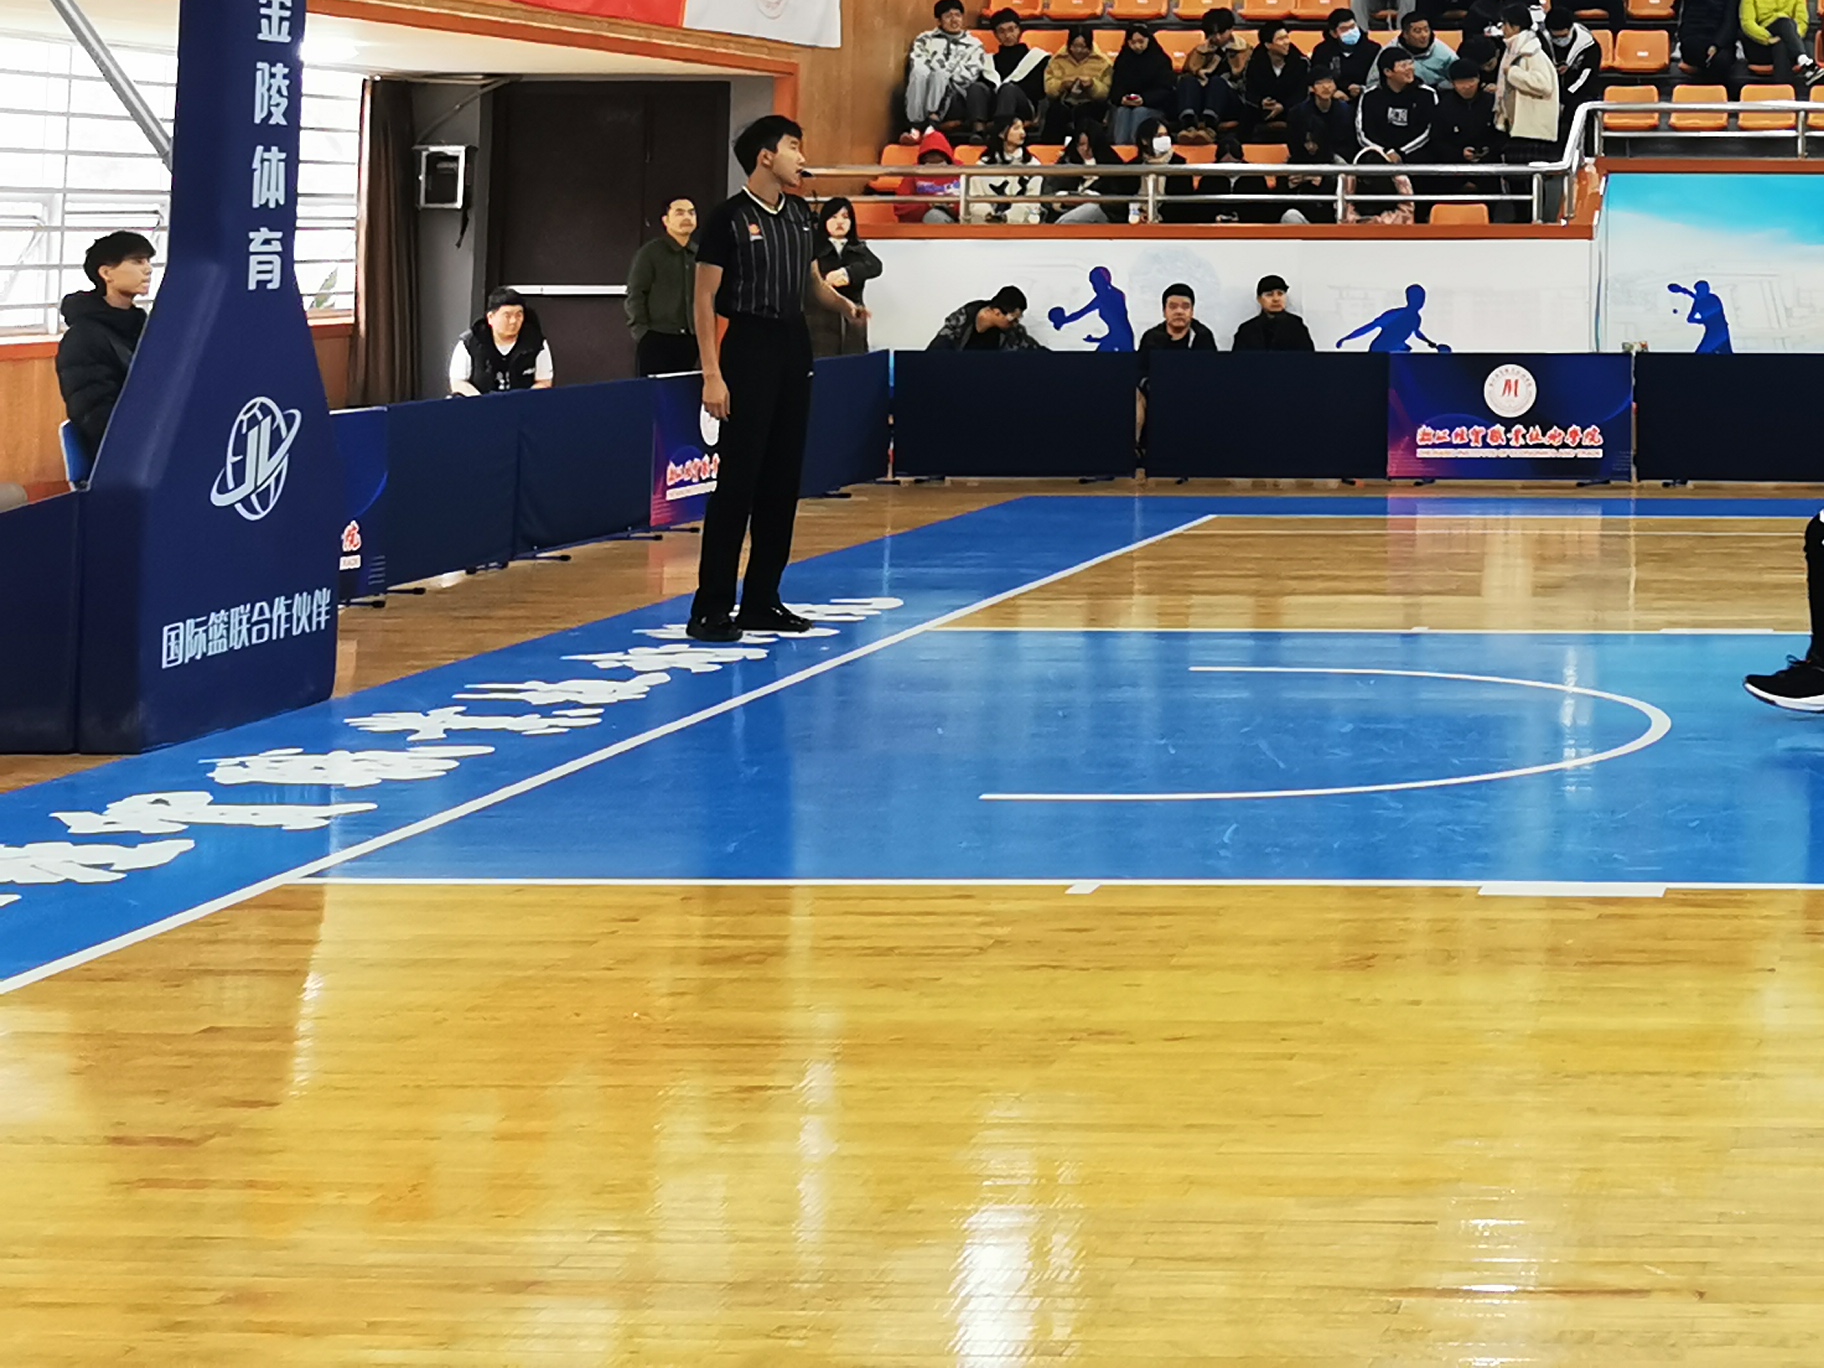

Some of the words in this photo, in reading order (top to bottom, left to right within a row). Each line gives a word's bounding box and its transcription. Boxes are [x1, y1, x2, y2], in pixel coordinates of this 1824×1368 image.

[162, 587, 331, 669] 国际篮联合作伙伴
